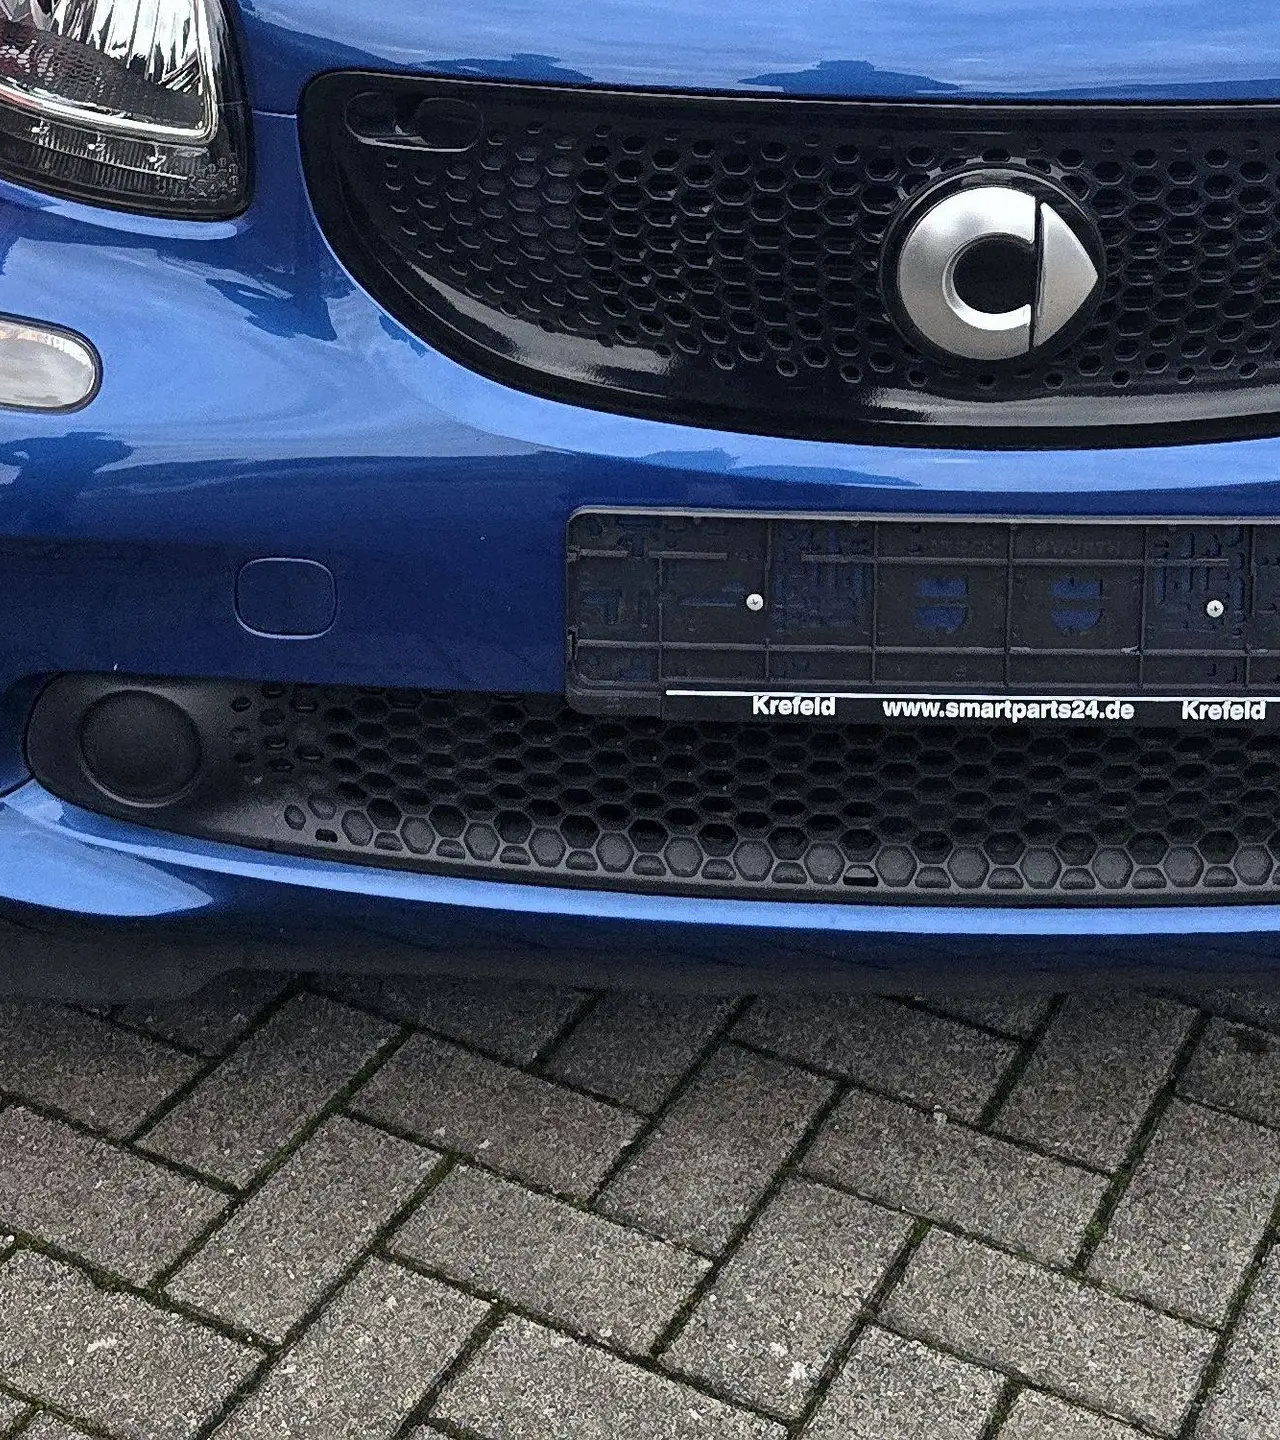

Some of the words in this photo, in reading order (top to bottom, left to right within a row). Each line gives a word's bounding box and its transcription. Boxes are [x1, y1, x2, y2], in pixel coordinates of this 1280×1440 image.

[752, 695, 836, 716] Krefeld
[882, 699, 1135, 723] www.smartparts24.de
[1181, 699, 1267, 720] Krefeld
